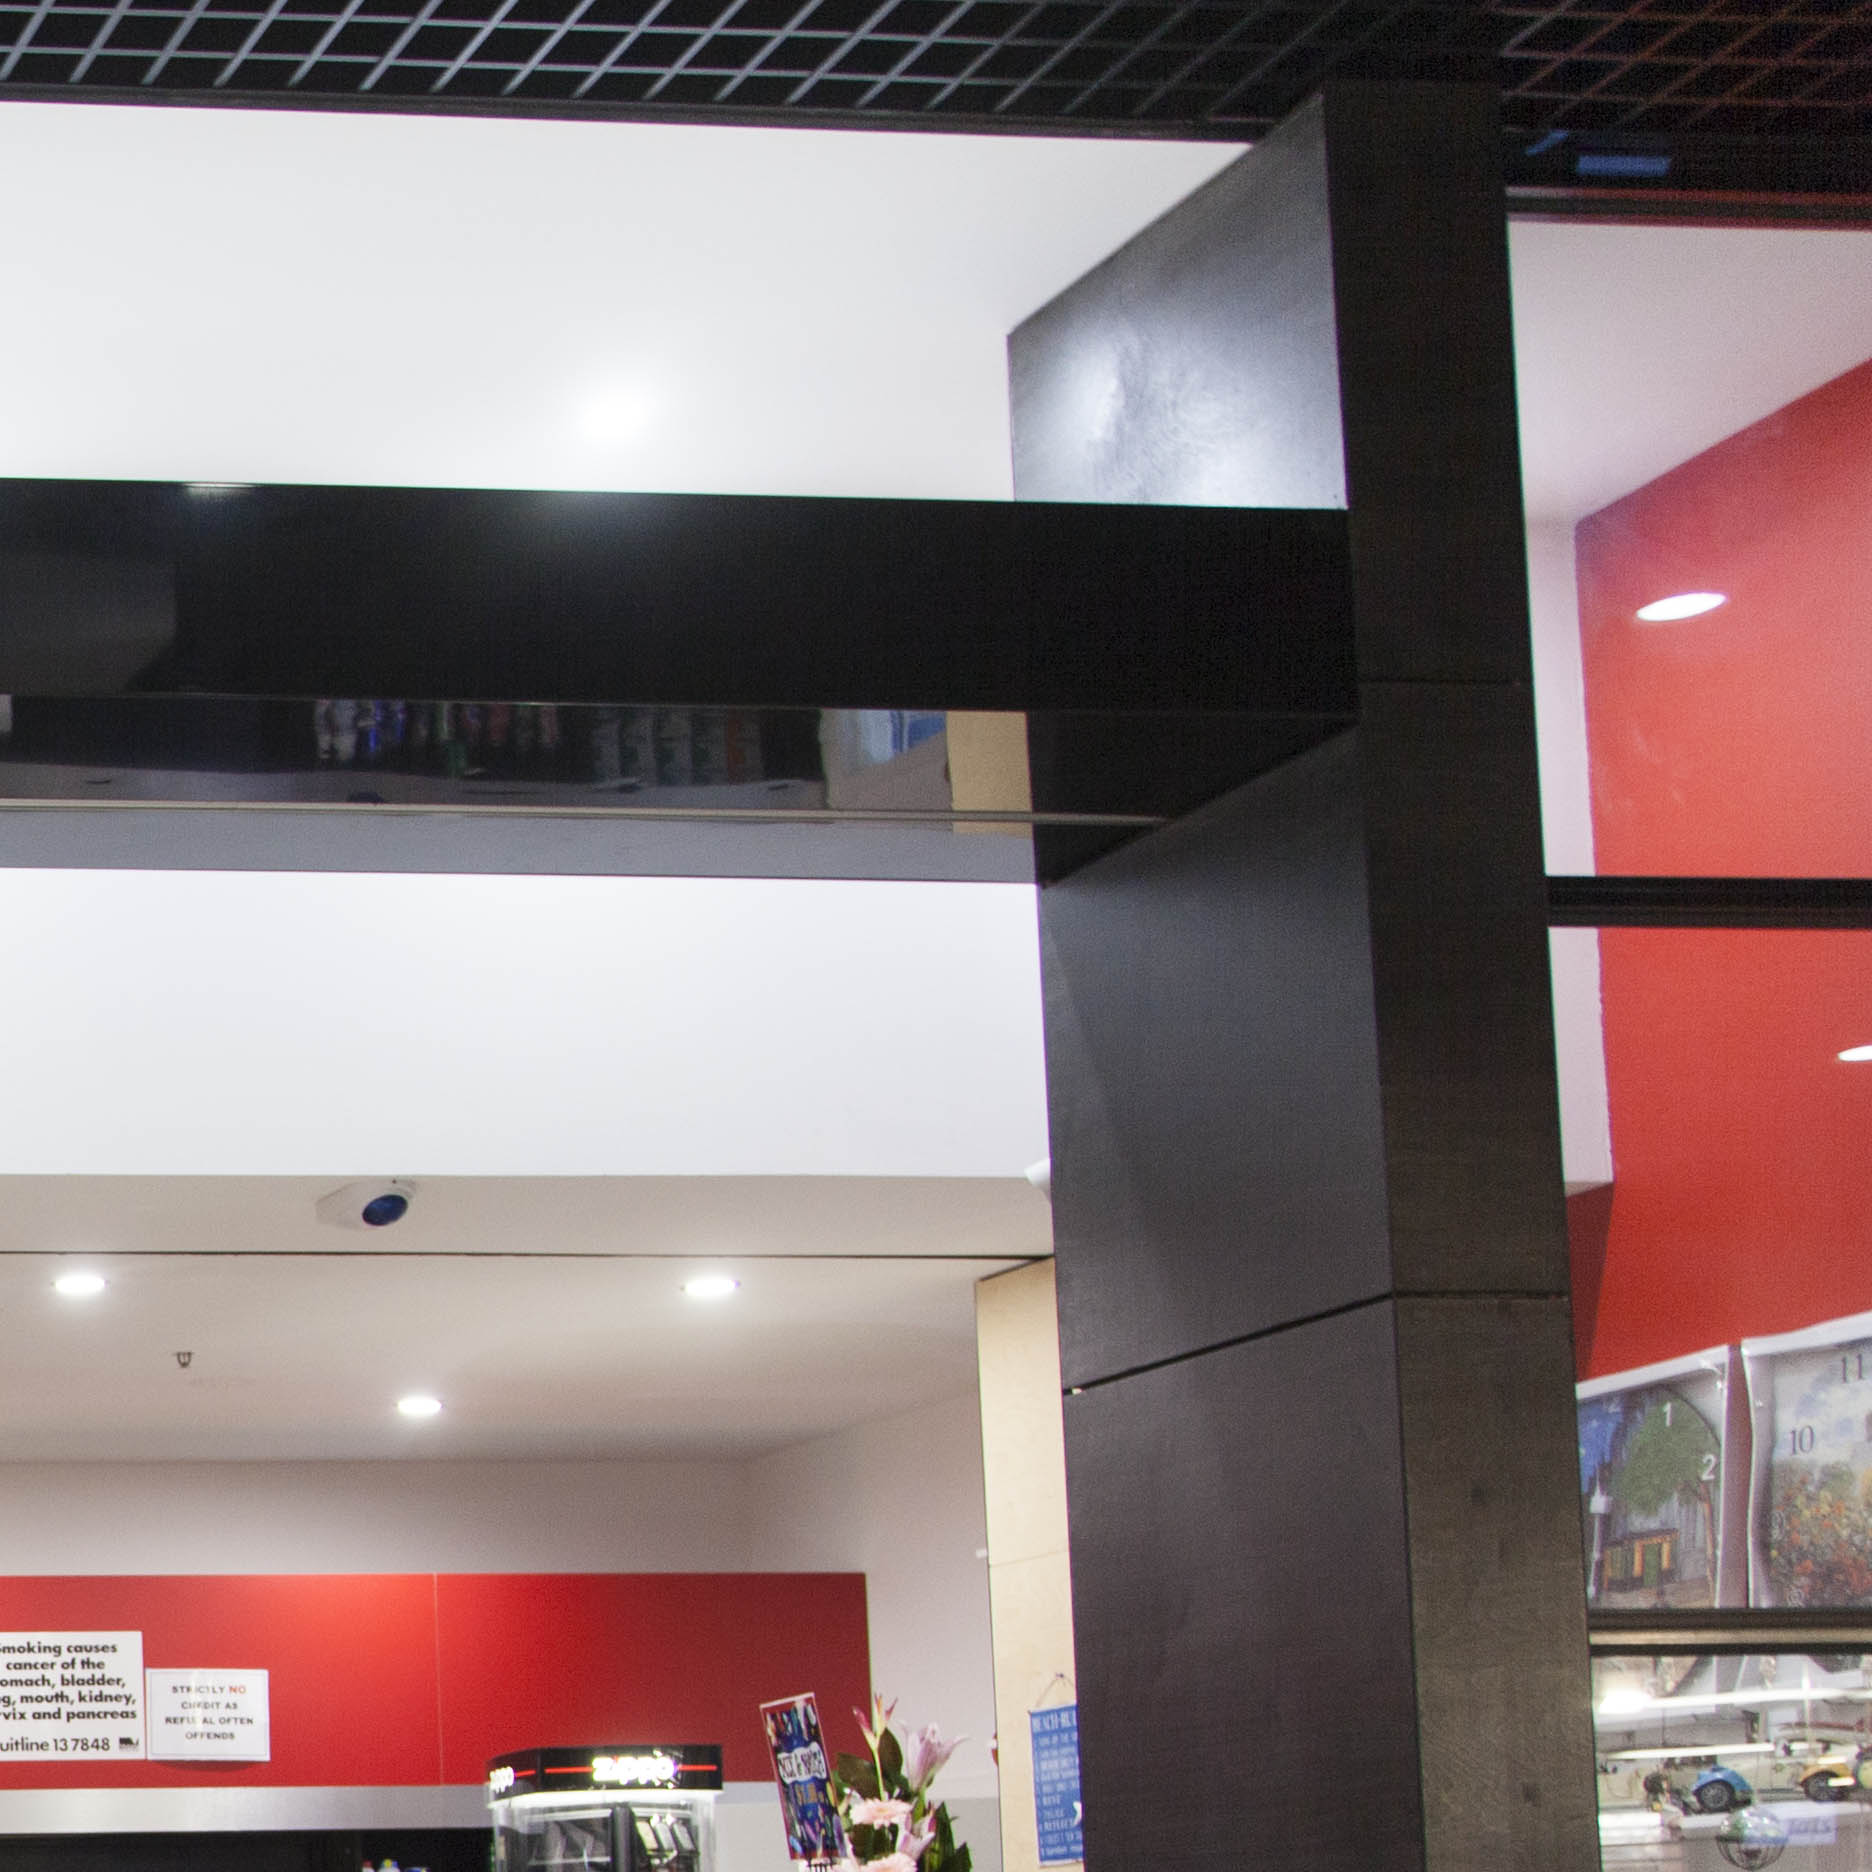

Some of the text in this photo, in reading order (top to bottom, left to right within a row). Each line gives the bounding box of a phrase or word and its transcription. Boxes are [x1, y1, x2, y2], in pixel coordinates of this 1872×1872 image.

[1790, 1425, 1814, 1455] 10
[1702, 1454, 1716, 1481] 2
[66, 1643, 117, 1653] causes
[6, 1659, 105, 1671] cancer of the
[61, 1674, 126, 1688] bladder,
[229, 1685, 246, 1694] NO
[20, 1692, 74, 1705] mouth,
[78, 1691, 136, 1706] kidney,
[224, 1702, 238, 1710] AS
[32, 1708, 62, 1720] and
[66, 1709, 136, 1722] pancreas
[218, 1717, 254, 1725] OFTEN
[185, 1731, 235, 1740] OFFENDS
